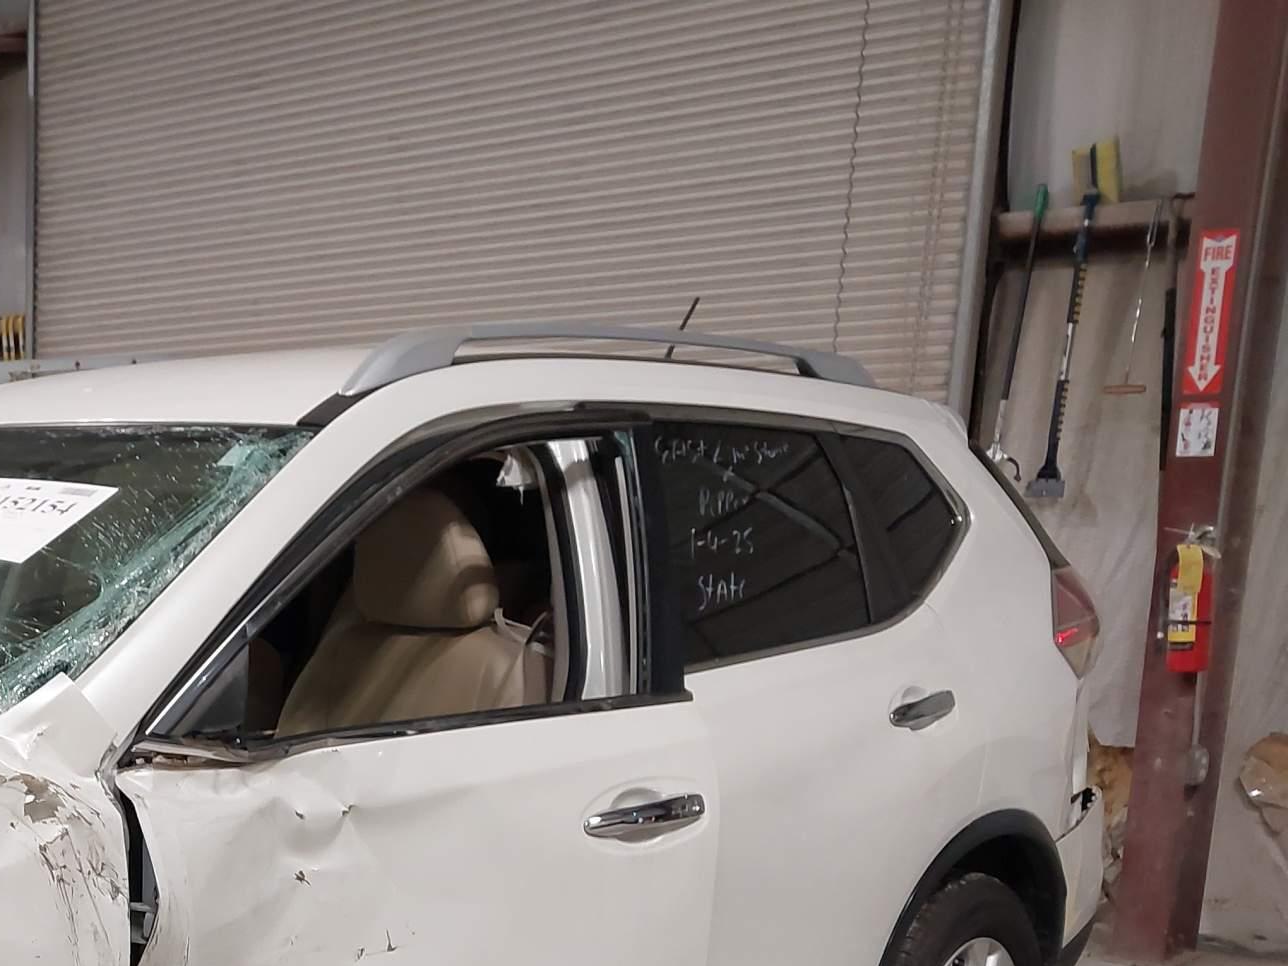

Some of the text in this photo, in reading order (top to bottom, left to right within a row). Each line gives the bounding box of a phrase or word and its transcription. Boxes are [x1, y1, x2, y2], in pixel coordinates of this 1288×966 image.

[1204, 244, 1233, 262] FIRE
[1197, 266, 1221, 381] EXTINGUISHER
[690, 527, 754, 560] 1-4-25
